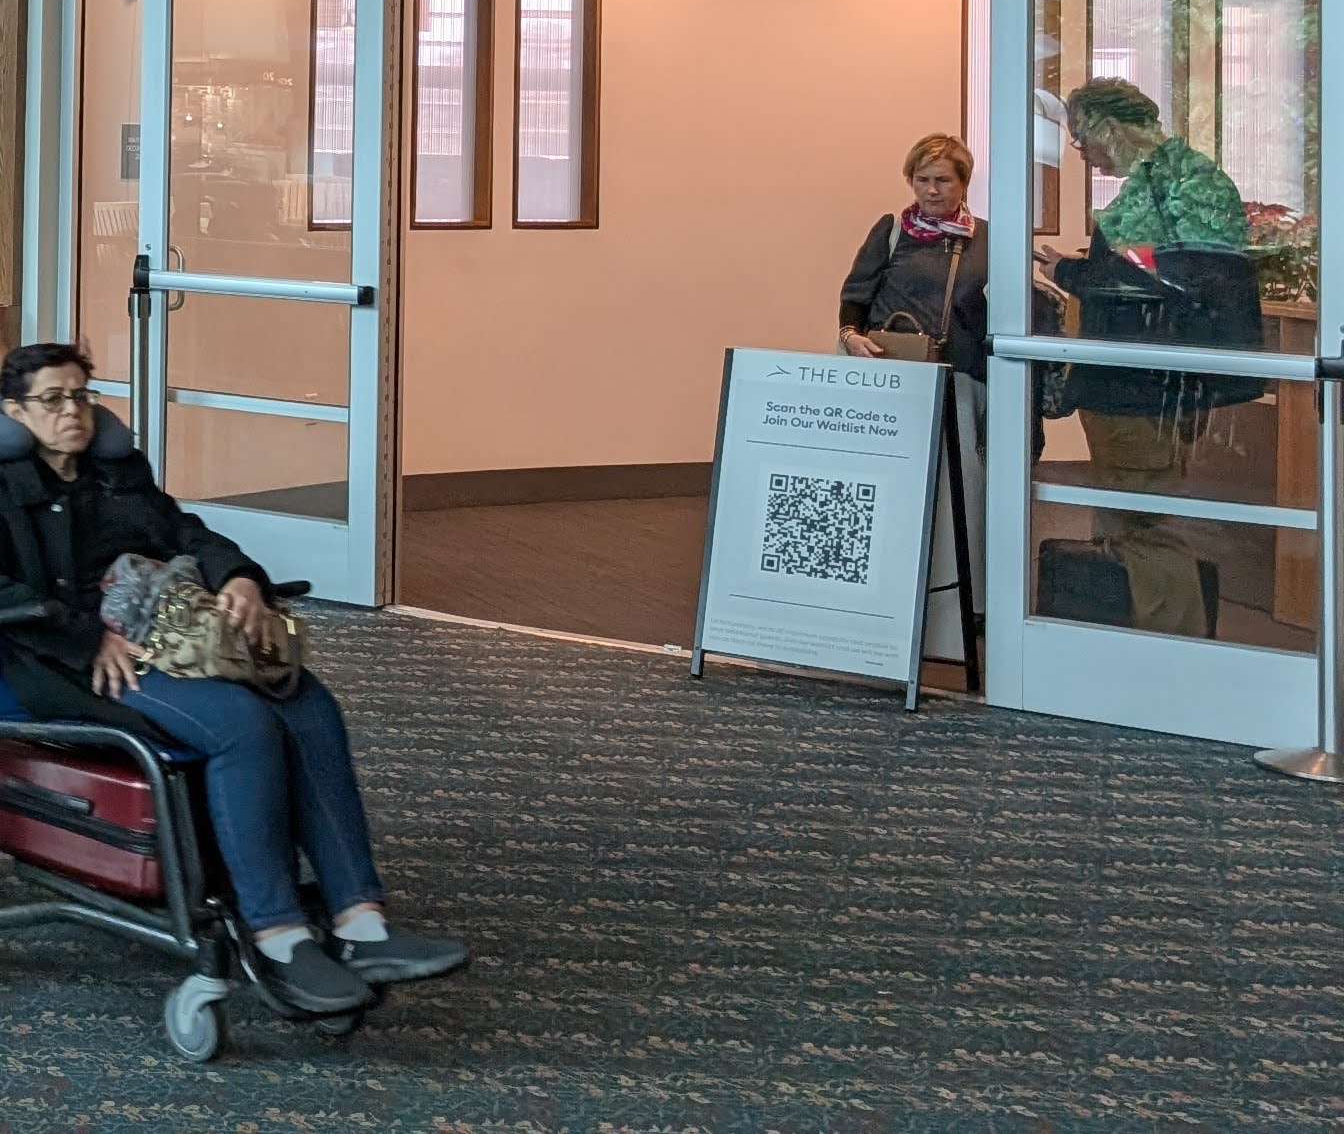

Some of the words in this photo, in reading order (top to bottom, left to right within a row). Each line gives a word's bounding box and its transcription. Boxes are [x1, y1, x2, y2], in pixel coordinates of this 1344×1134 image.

[798, 367, 838, 384] THE
[845, 371, 901, 389] CLUB
[765, 401, 797, 414] Scan
[799, 404, 821, 416] the
[823, 406, 843, 419] QR
[846, 409, 880, 422] Code
[883, 413, 898, 424] to
[762, 415, 788, 426] Join
[790, 417, 815, 429] Our
[816, 419, 866, 435] Waitlist
[868, 424, 899, 438] Now
